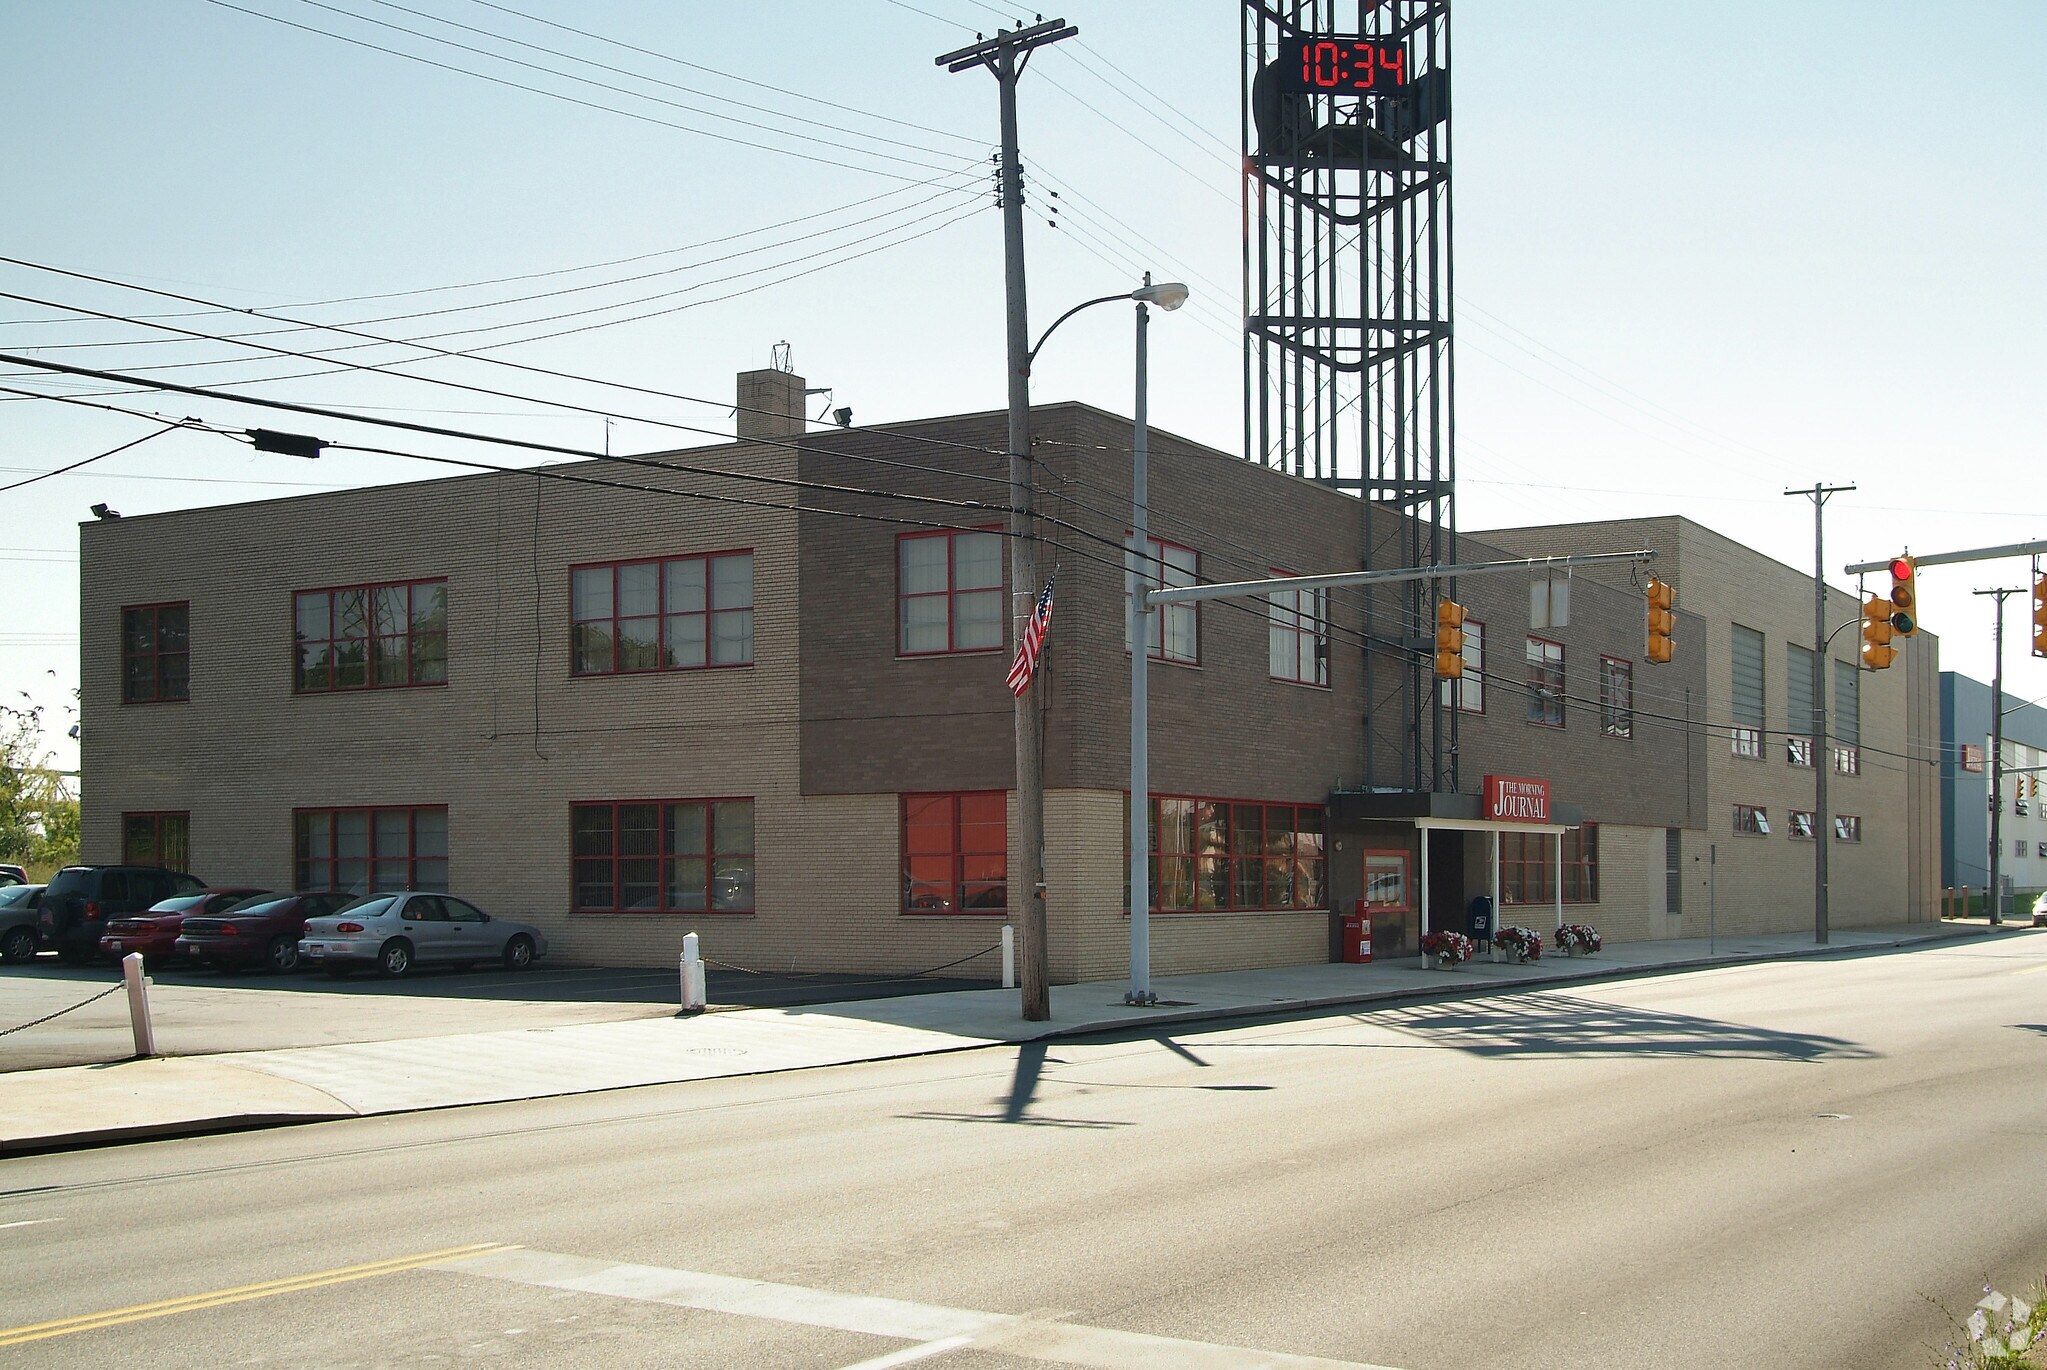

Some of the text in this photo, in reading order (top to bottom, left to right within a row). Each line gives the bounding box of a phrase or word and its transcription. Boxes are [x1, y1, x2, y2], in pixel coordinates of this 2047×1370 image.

[1302, 42, 1404, 88] 10:34
[1493, 780, 1546, 819] JOURNAL
[1505, 781, 1545, 796] THE MORNING
